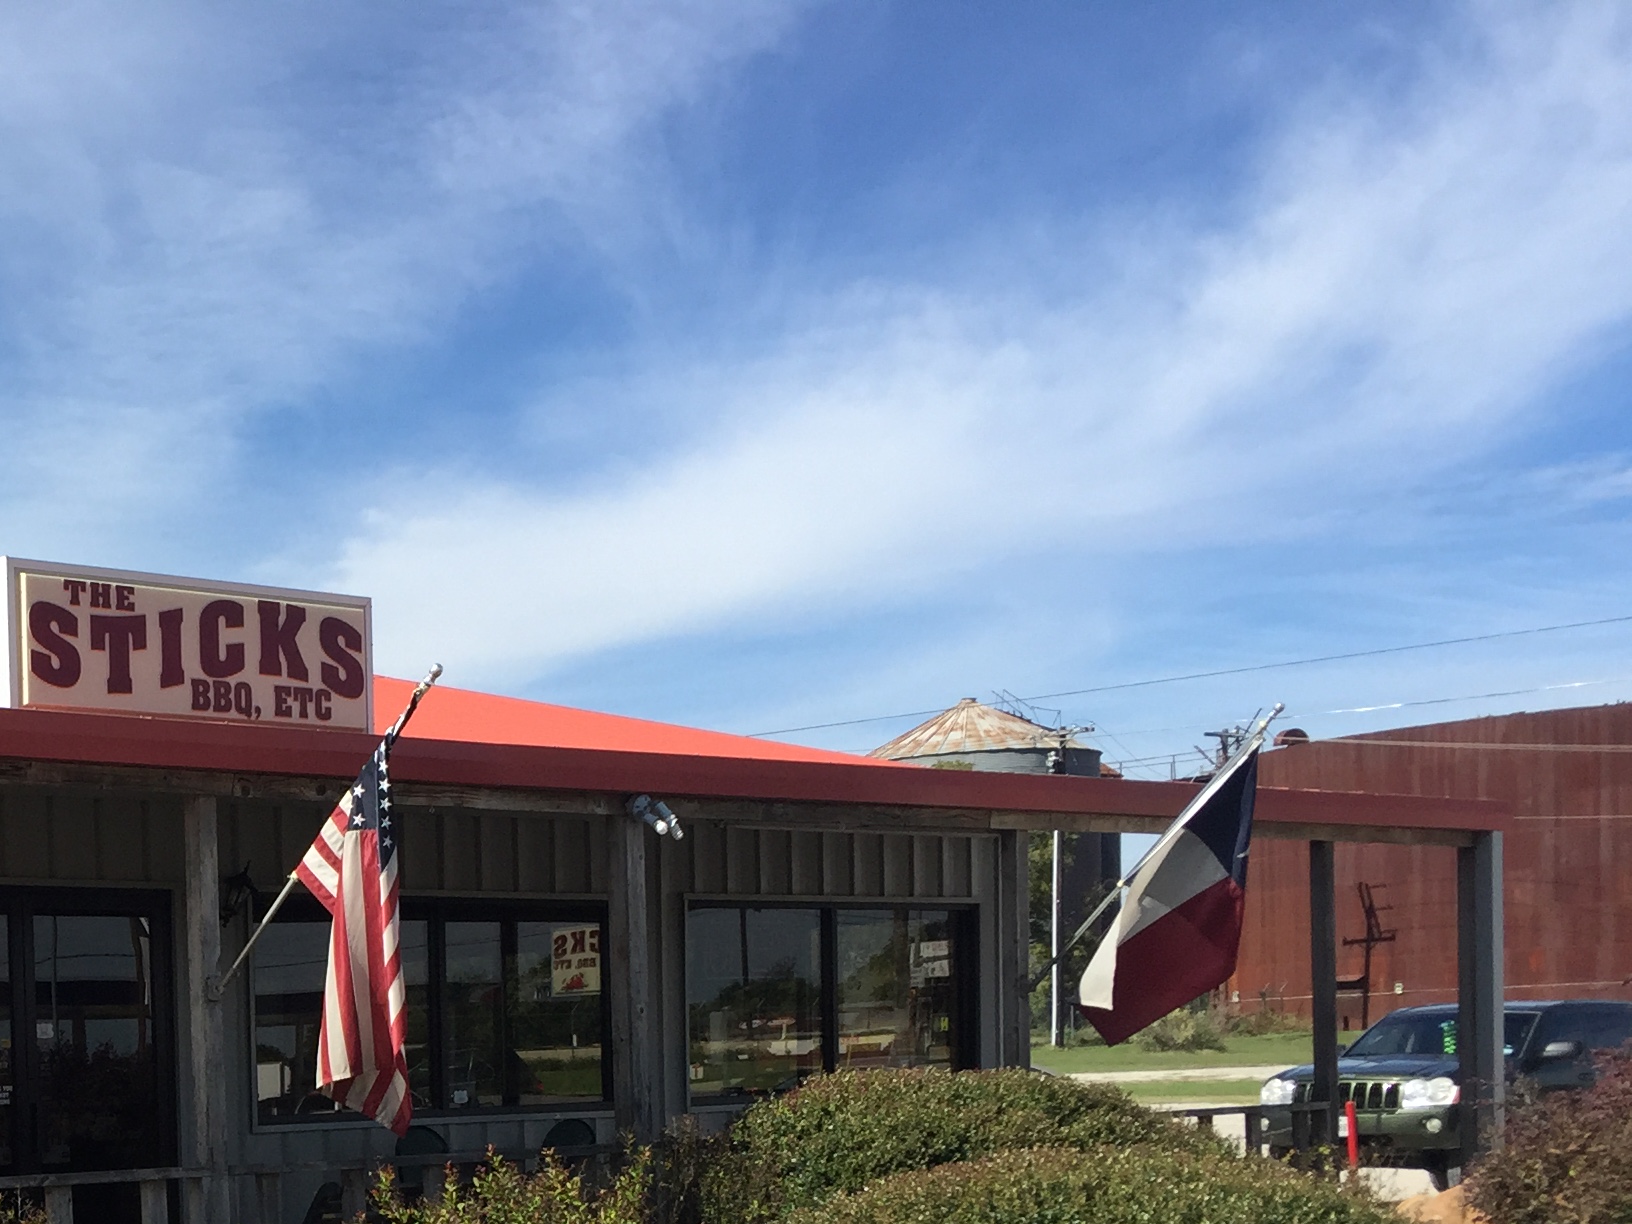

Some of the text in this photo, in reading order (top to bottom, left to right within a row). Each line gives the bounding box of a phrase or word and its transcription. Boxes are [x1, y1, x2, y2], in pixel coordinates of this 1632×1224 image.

[63, 579, 135, 612] THE
[29, 600, 364, 699] STICKS
[190, 678, 332, 721] BBQ, ETC
